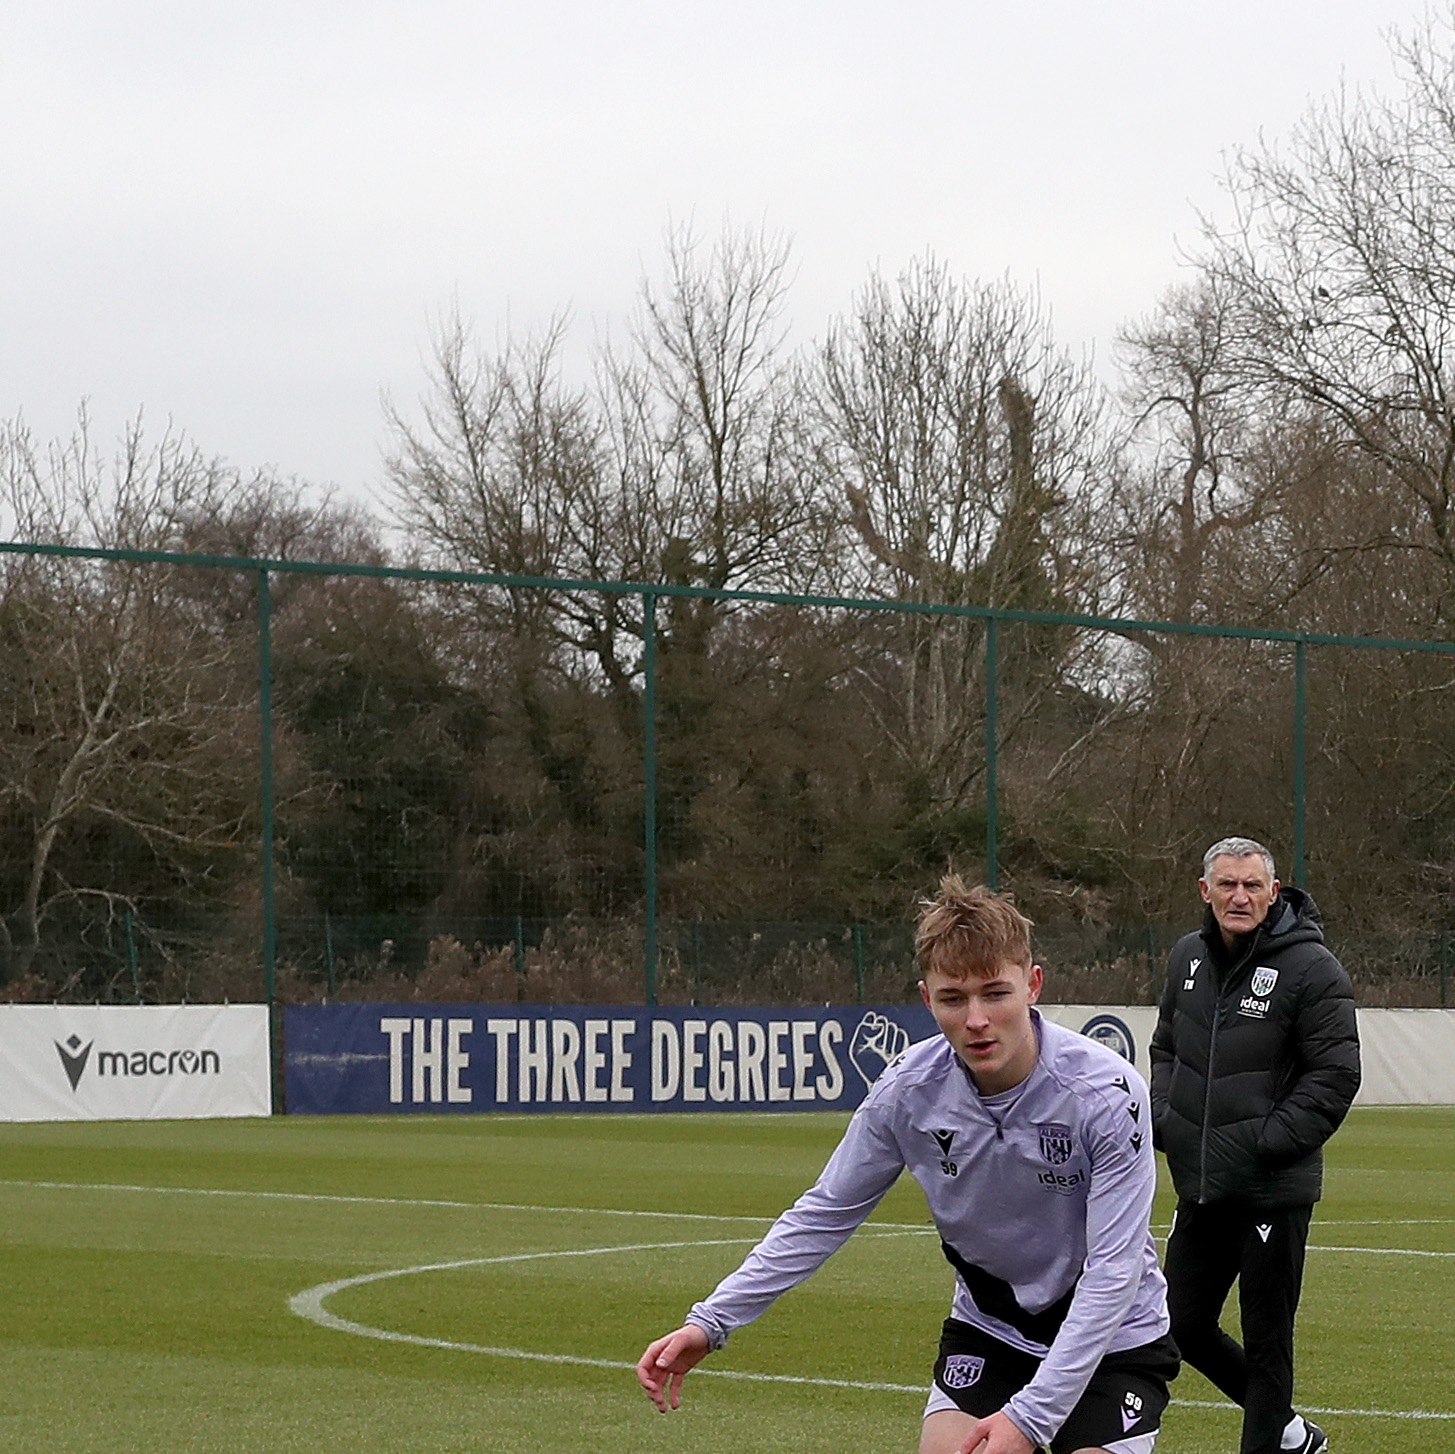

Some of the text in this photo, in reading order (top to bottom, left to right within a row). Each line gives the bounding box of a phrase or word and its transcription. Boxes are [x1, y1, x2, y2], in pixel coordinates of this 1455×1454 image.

[1240, 995, 1271, 1012] ideal
[98, 1050, 220, 1076] macron
[380, 1018, 844, 1103] THE THREE DEGREES
[941, 1161, 958, 1177] 59
[1038, 1168, 1085, 1187] ideal
[1125, 1391, 1142, 1410] 59
